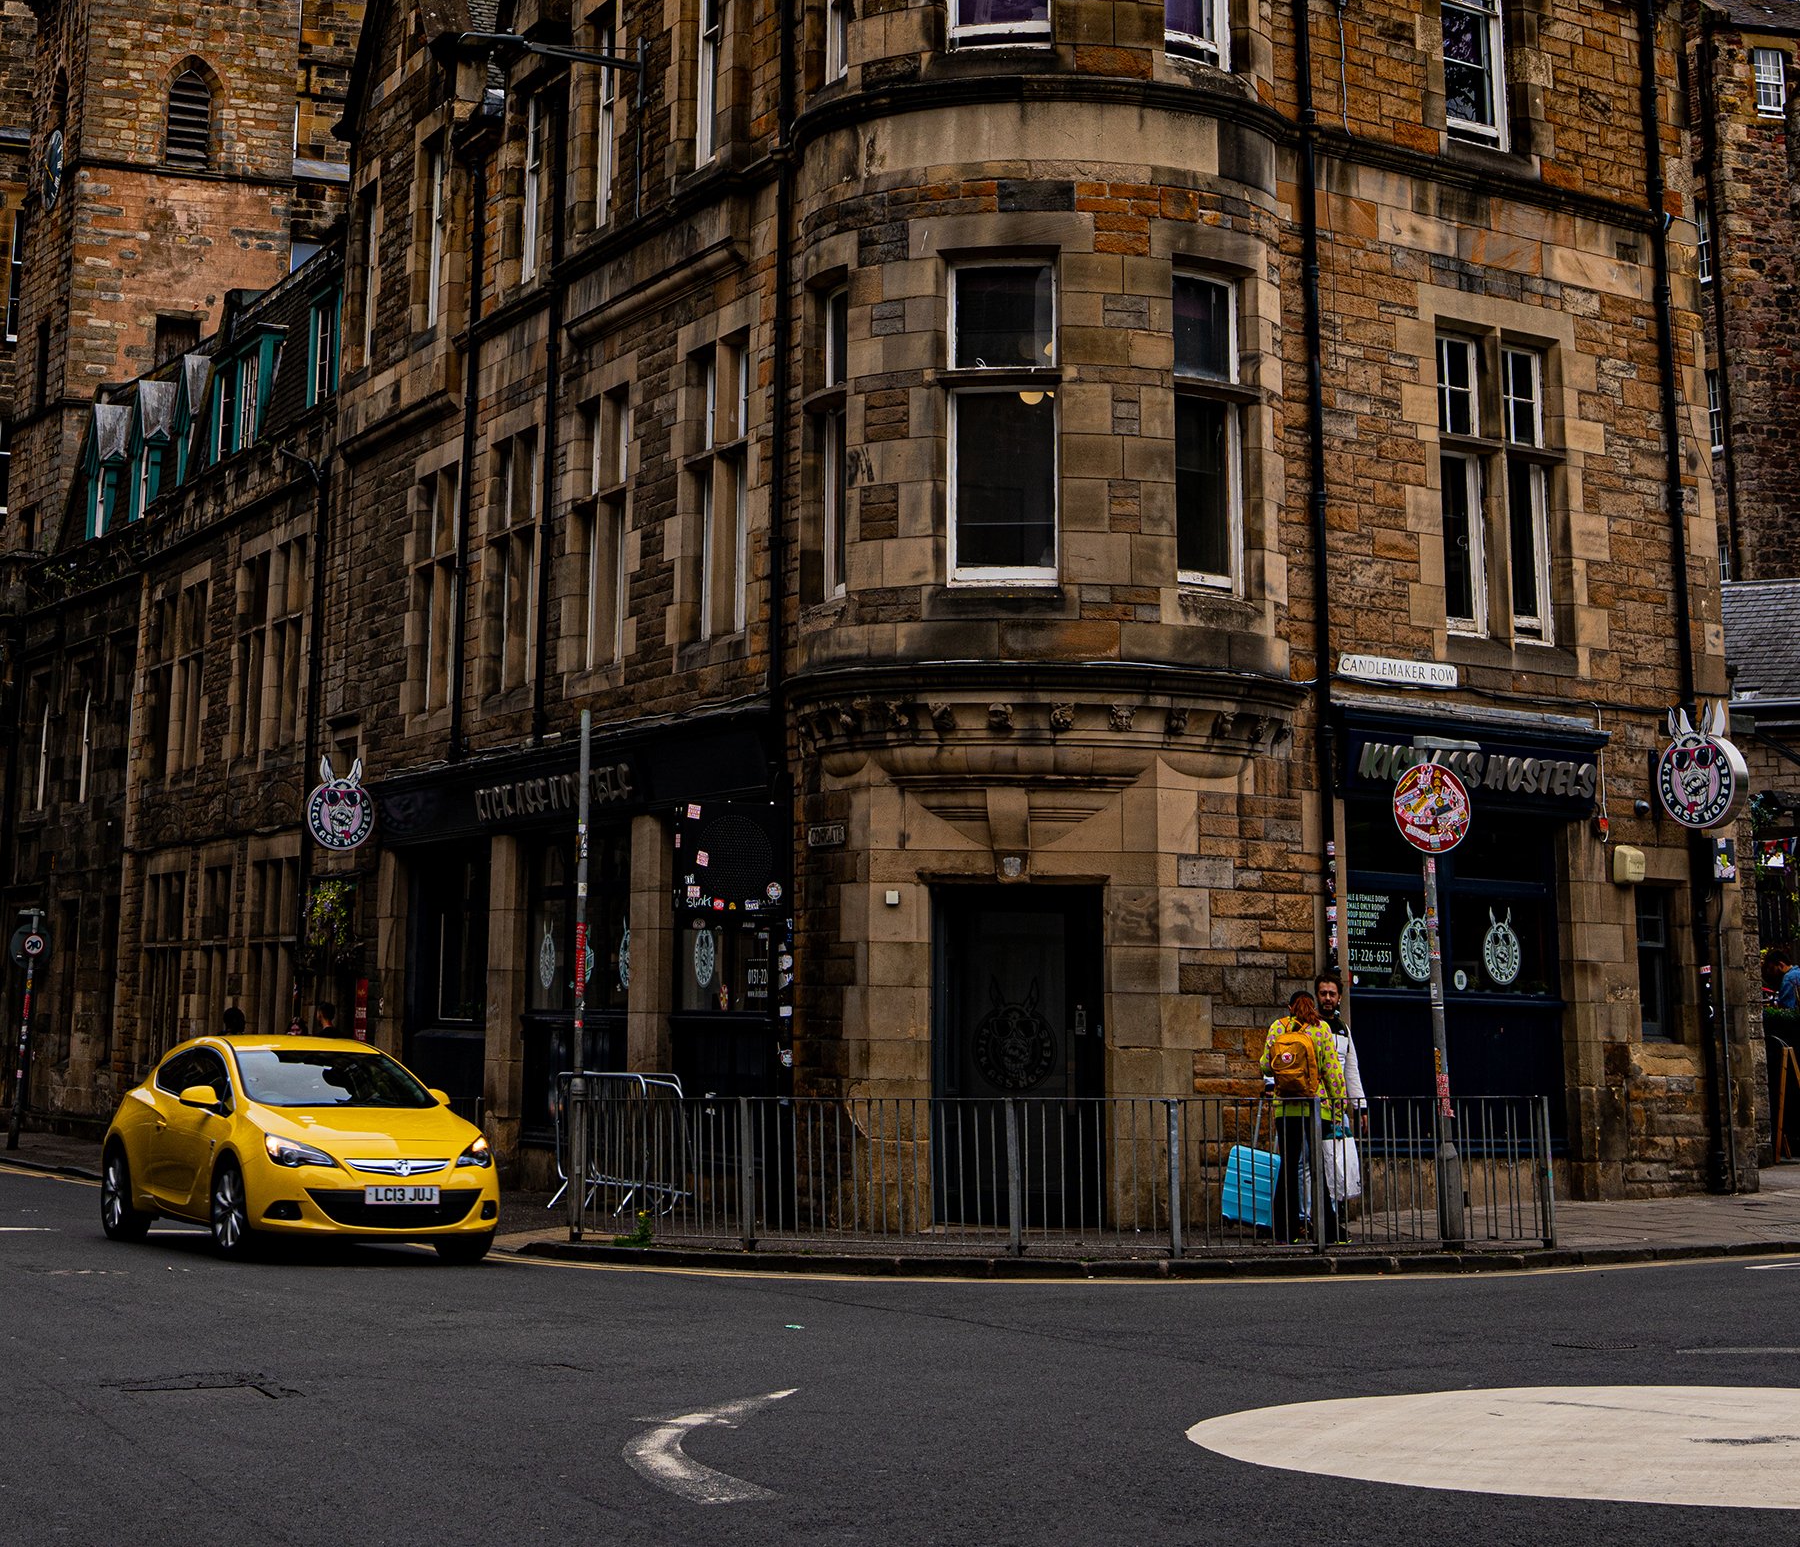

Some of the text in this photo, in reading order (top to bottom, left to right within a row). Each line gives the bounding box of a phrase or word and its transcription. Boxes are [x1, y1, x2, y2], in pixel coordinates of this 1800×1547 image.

[1341, 658, 1455, 682] CANDLEMAKER ROW
[1483, 754, 1597, 799] HOSTELS
[1662, 755, 1730, 823] KICK ASS HOSTELS
[475, 784, 515, 821] KICK
[515, 778, 549, 815] ASS
[311, 796, 323, 829] KICK
[318, 830, 340, 846] ASS
[343, 799, 371, 846] HOSTELS
[1347, 893, 1355, 901] ALE
[1359, 894, 1375, 903] FEMALE
[1375, 895, 1390, 904] DORMS
[1347, 901, 1386, 912] EMALE ONLY ROOMS
[1347, 910, 1359, 919] ROUP
[1359, 911, 1380, 920] BOOKINGS
[1347, 919, 1377, 928] RIVATE ROOMS
[375, 1187, 434, 1202] LC13 JUJ
